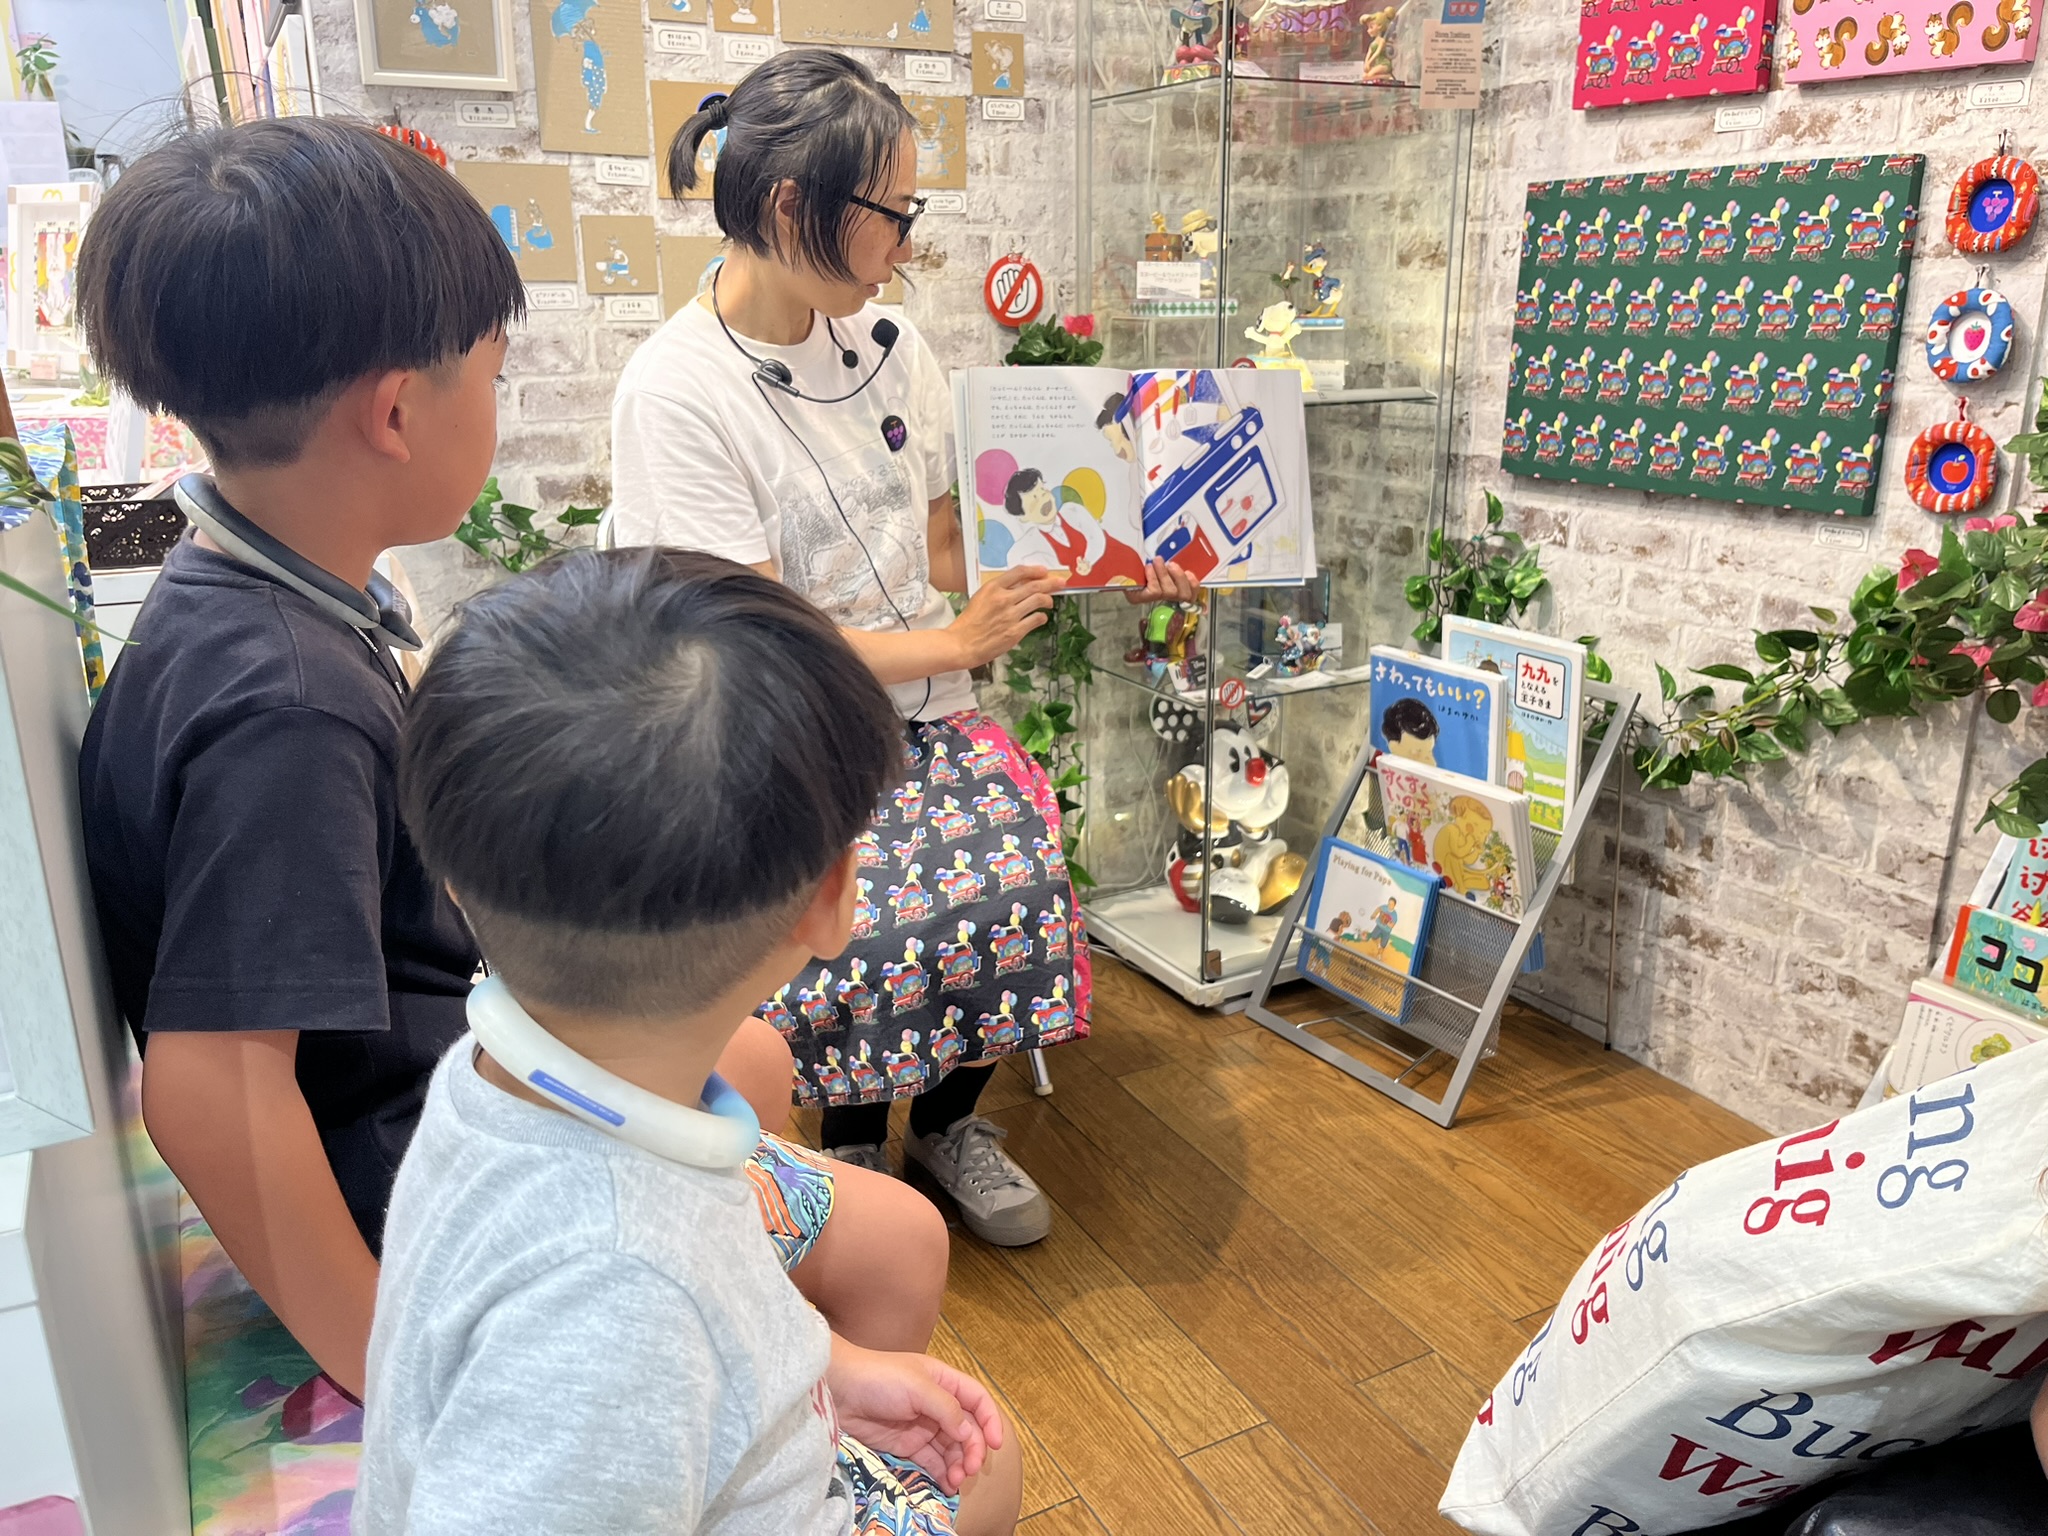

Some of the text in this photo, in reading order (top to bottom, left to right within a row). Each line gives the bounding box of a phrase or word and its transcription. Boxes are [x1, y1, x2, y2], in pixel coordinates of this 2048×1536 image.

[1333, 854, 1392, 886] Playing for Papa
[1705, 1388, 1982, 1460] Buc
